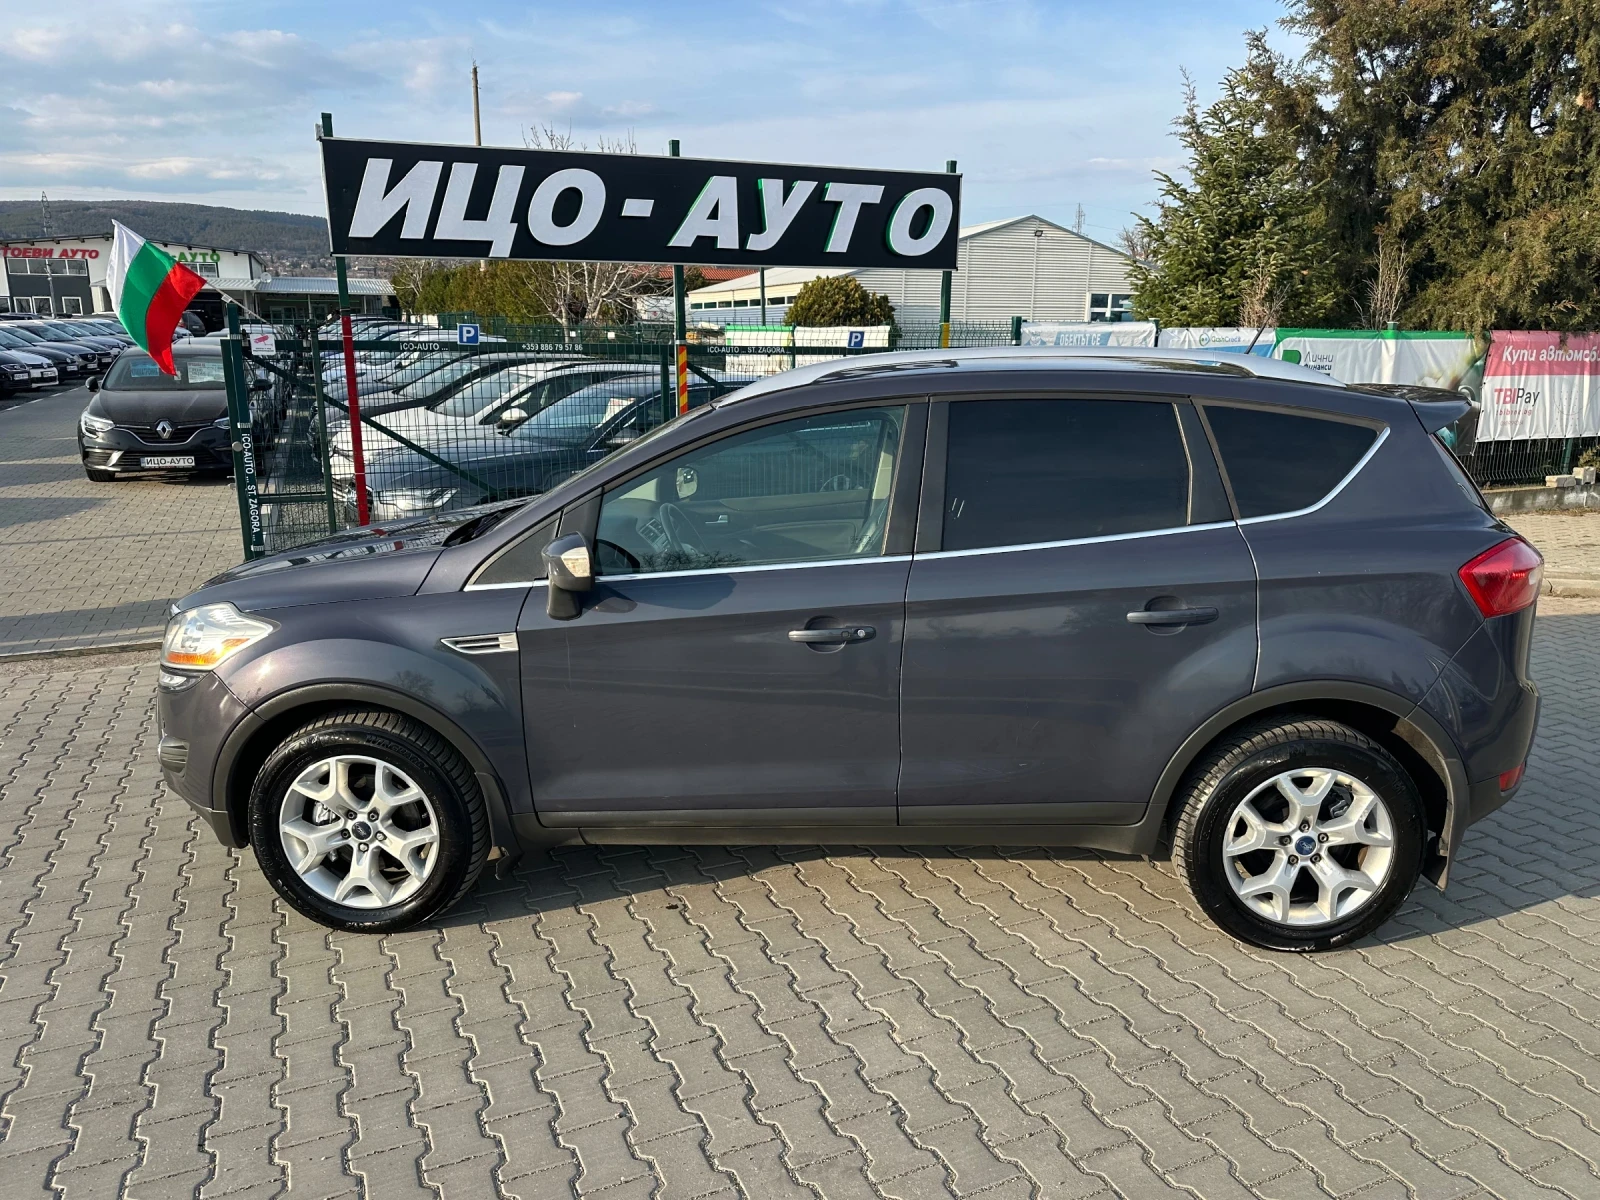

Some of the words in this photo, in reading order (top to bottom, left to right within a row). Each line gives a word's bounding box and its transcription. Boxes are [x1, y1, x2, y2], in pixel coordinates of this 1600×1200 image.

[667, 175, 954, 258] АУТО
[0, 247, 54, 258] ТОЕВИ
[58, 248, 100, 259] АУТО
[462, 327, 475, 342] P
[850, 332, 861, 346] P
[541, 343, 553, 351] 886
[555, 343, 563, 351] 79
[565, 343, 574, 351] 57
[575, 343, 583, 351] 86
[758, 346, 785, 354] ZAGORA
[1304, 351, 1334, 363] Лични
[1502, 345, 1536, 365] Купи
[1494, 387, 1540, 407] TBIPay
[146, 457, 194, 466] ИЦО-АУТО
[249, 498, 260, 533] ZAGORA
